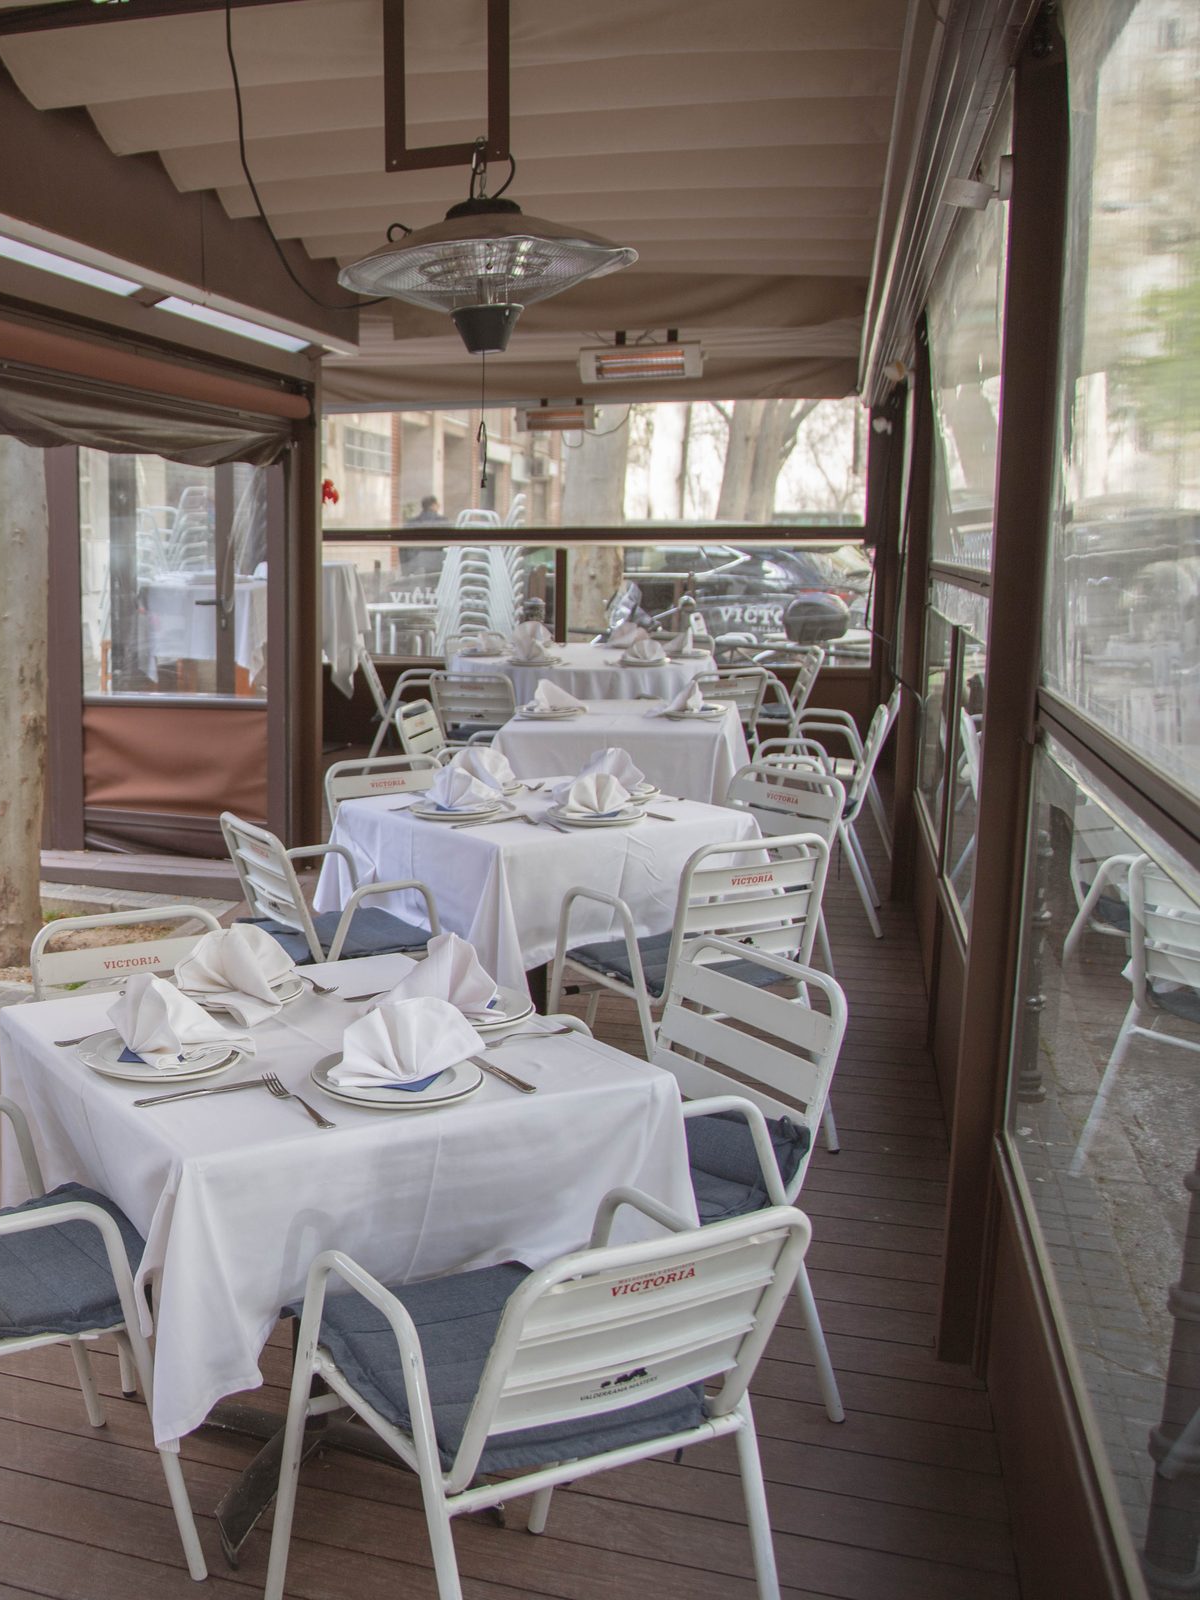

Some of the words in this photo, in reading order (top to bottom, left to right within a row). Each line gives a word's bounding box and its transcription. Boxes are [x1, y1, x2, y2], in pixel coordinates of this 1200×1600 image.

[720, 604, 784, 626] VICTO
[369, 779, 406, 789] VICTORIA
[766, 792, 799, 805] VICTORIA
[731, 874, 774, 886] VICTORIA
[104, 956, 161, 969] VICTORIA
[610, 1267, 696, 1297] VICTORIA
